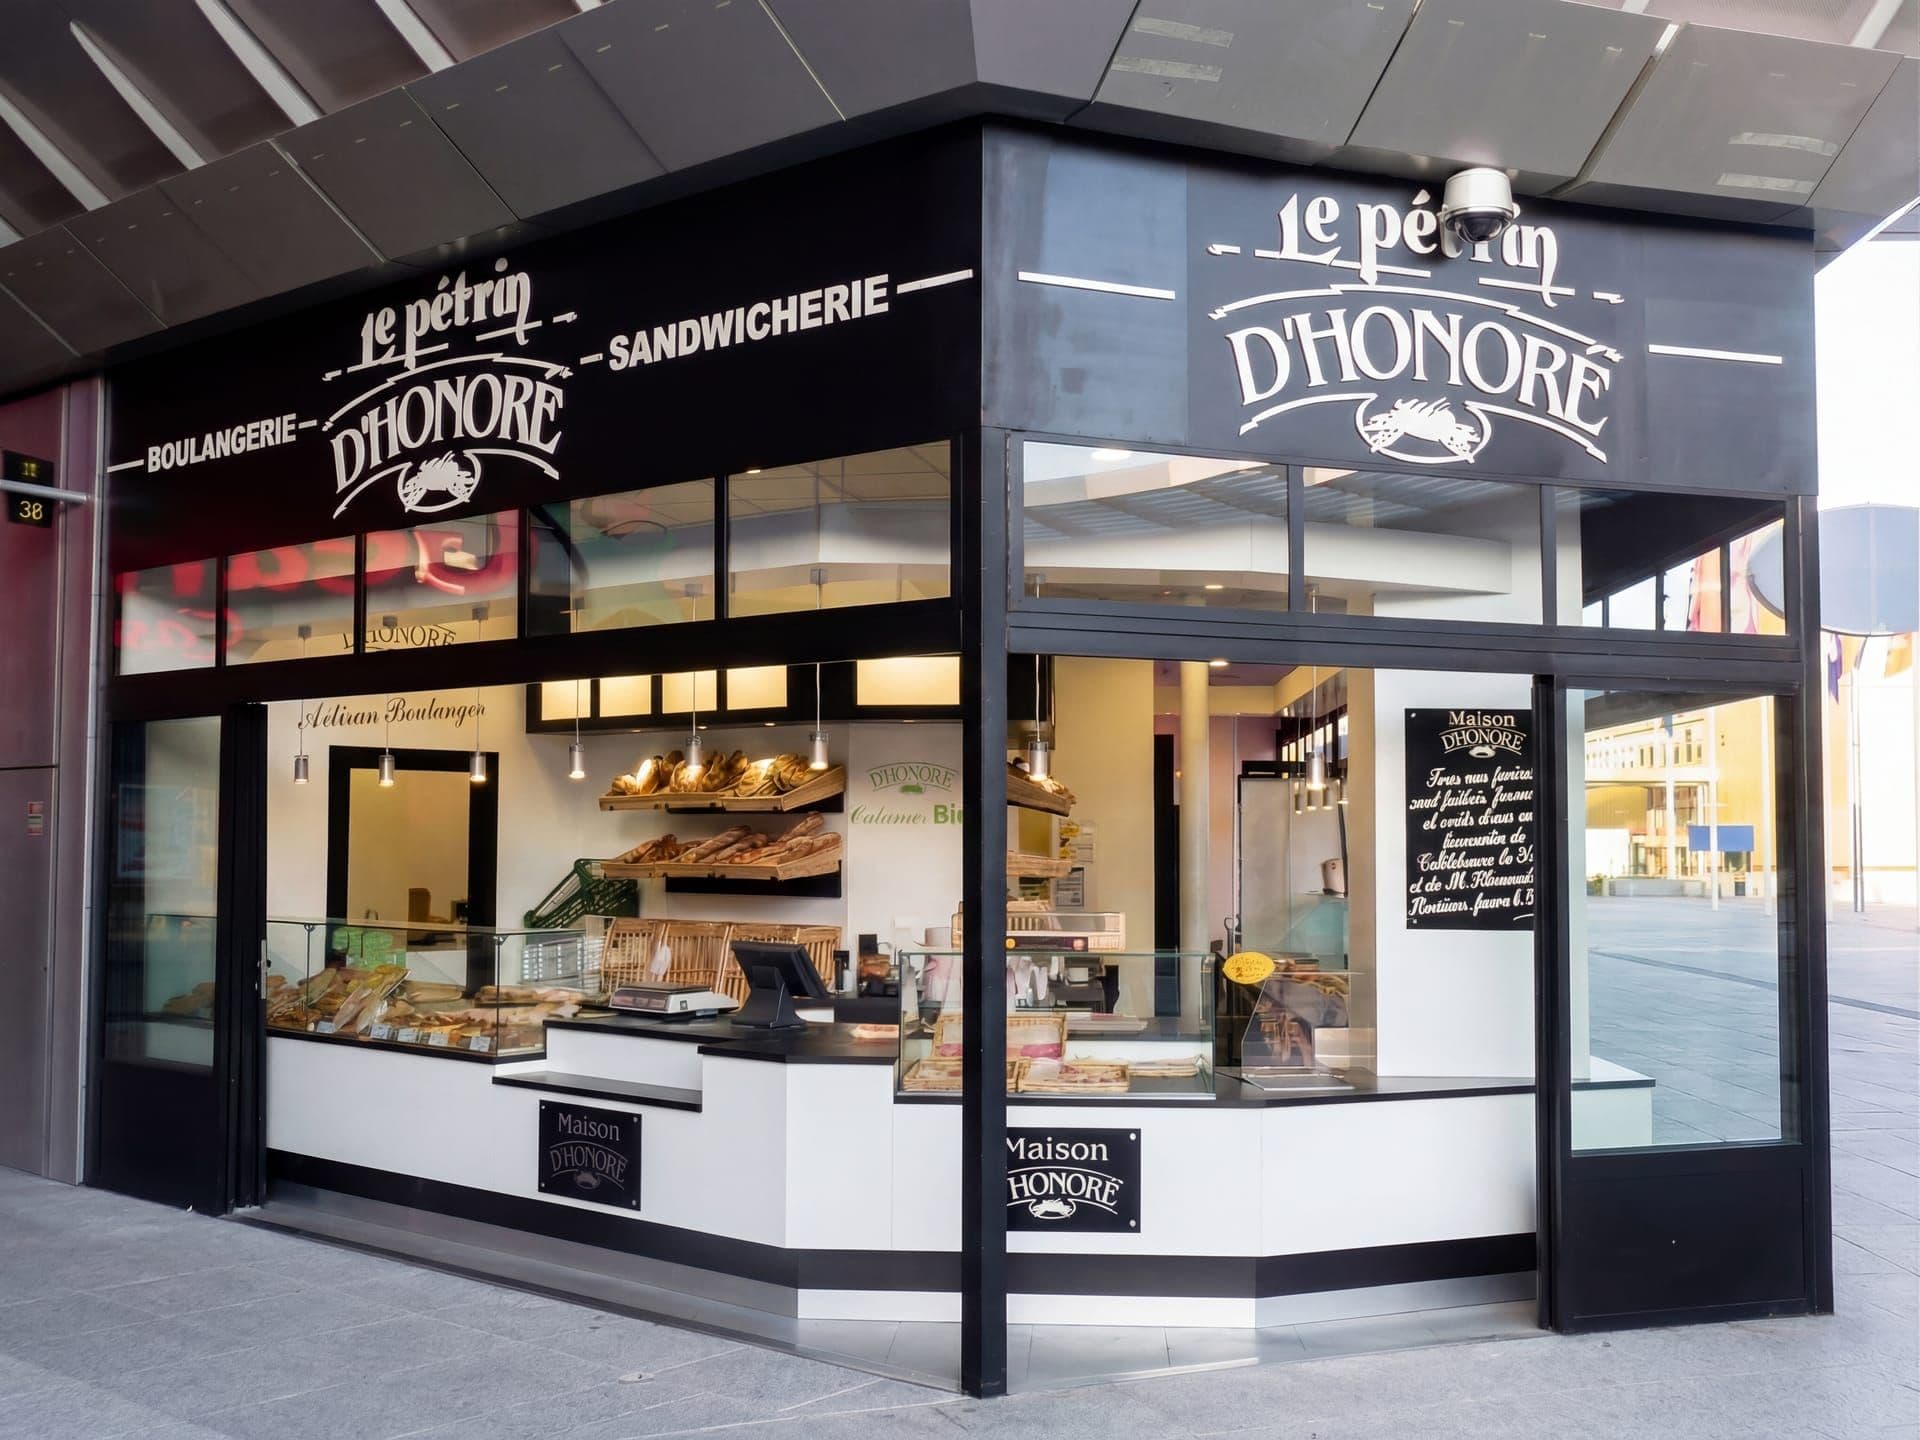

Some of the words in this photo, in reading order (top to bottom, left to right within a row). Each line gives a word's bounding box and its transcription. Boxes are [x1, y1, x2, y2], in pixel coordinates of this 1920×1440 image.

[1278, 193, 1342, 266] Le
[361, 303, 397, 370] Le
[404, 258, 532, 370] pétrin
[608, 273, 889, 371] SANDWICHERIE
[147, 412, 298, 473] BOULANGERIE
[1448, 711, 1517, 727] Maison
[559, 1113, 620, 1141] Maison
